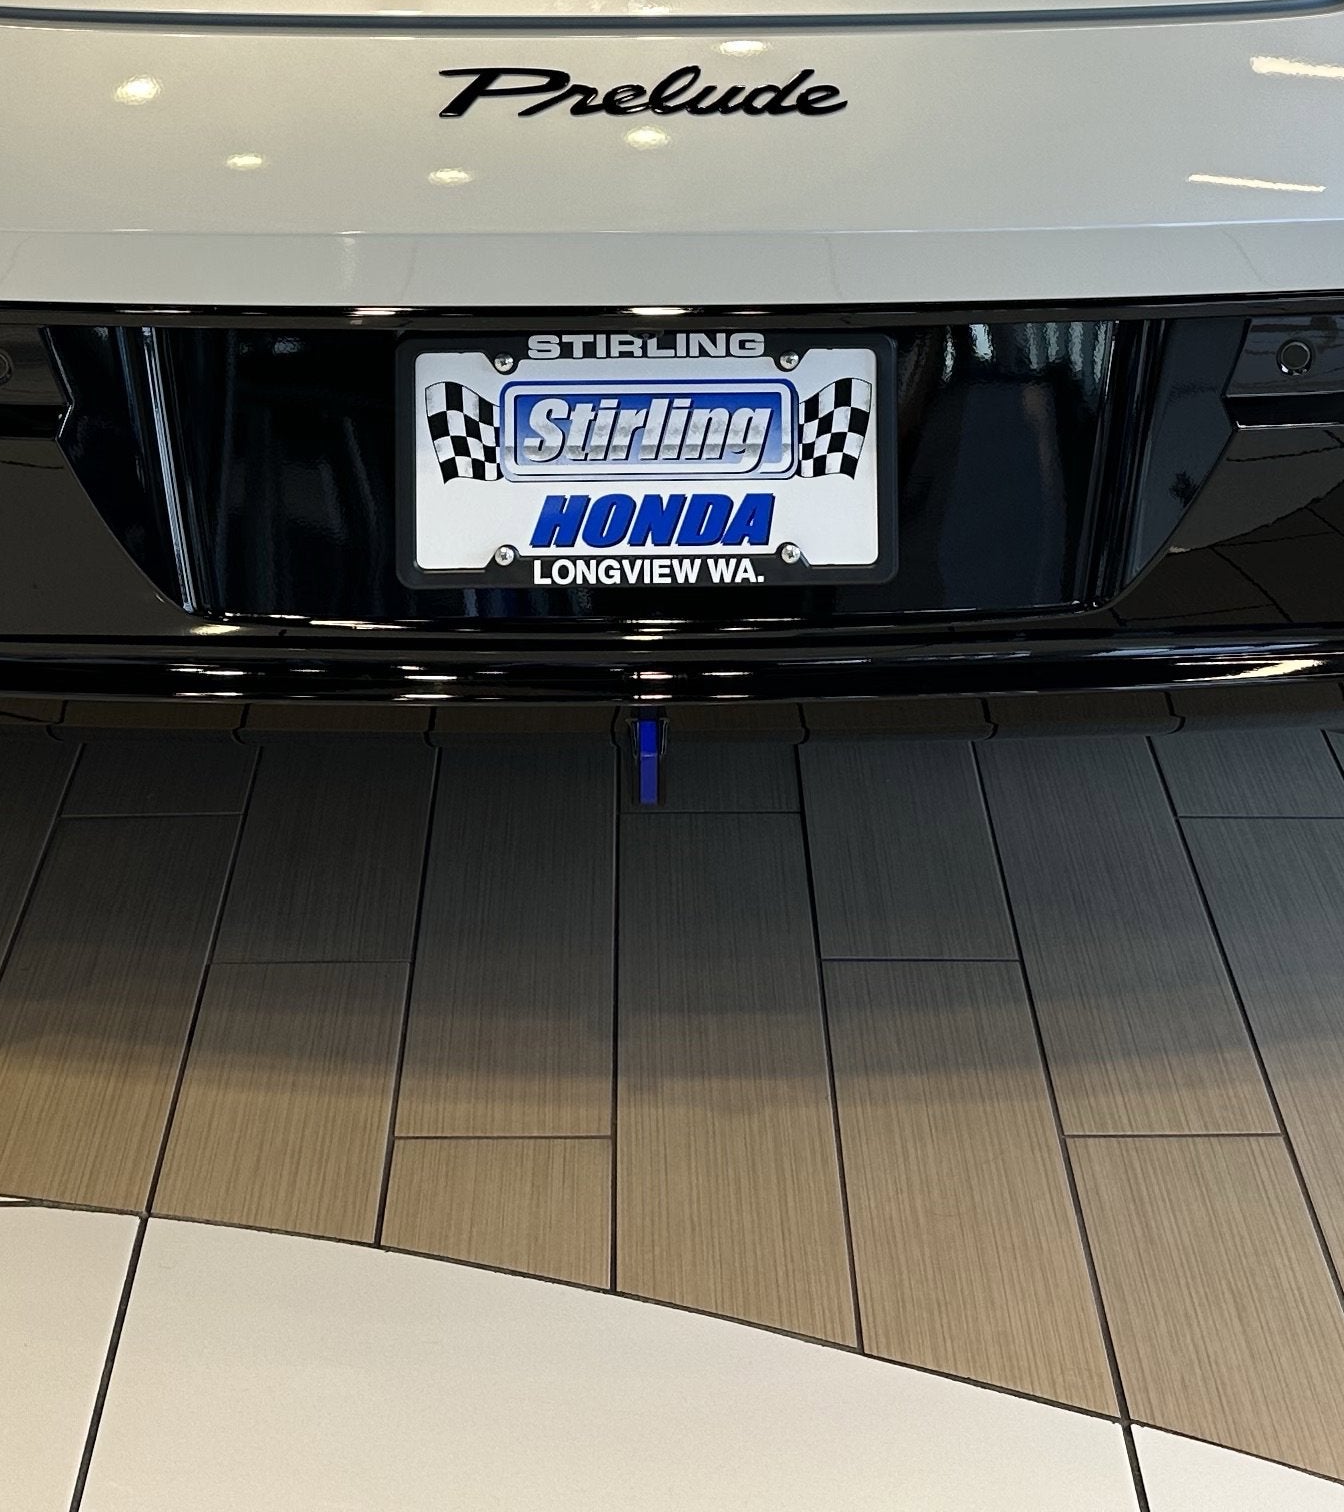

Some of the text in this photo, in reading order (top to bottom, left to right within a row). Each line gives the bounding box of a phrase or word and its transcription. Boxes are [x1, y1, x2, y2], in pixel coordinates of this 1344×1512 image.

[438, 65, 848, 117] Prelude
[527, 332, 765, 359] STIRLING
[522, 397, 773, 473] Stirling
[529, 493, 775, 548] HONDA
[533, 557, 765, 585] LONGVIEW WA.
